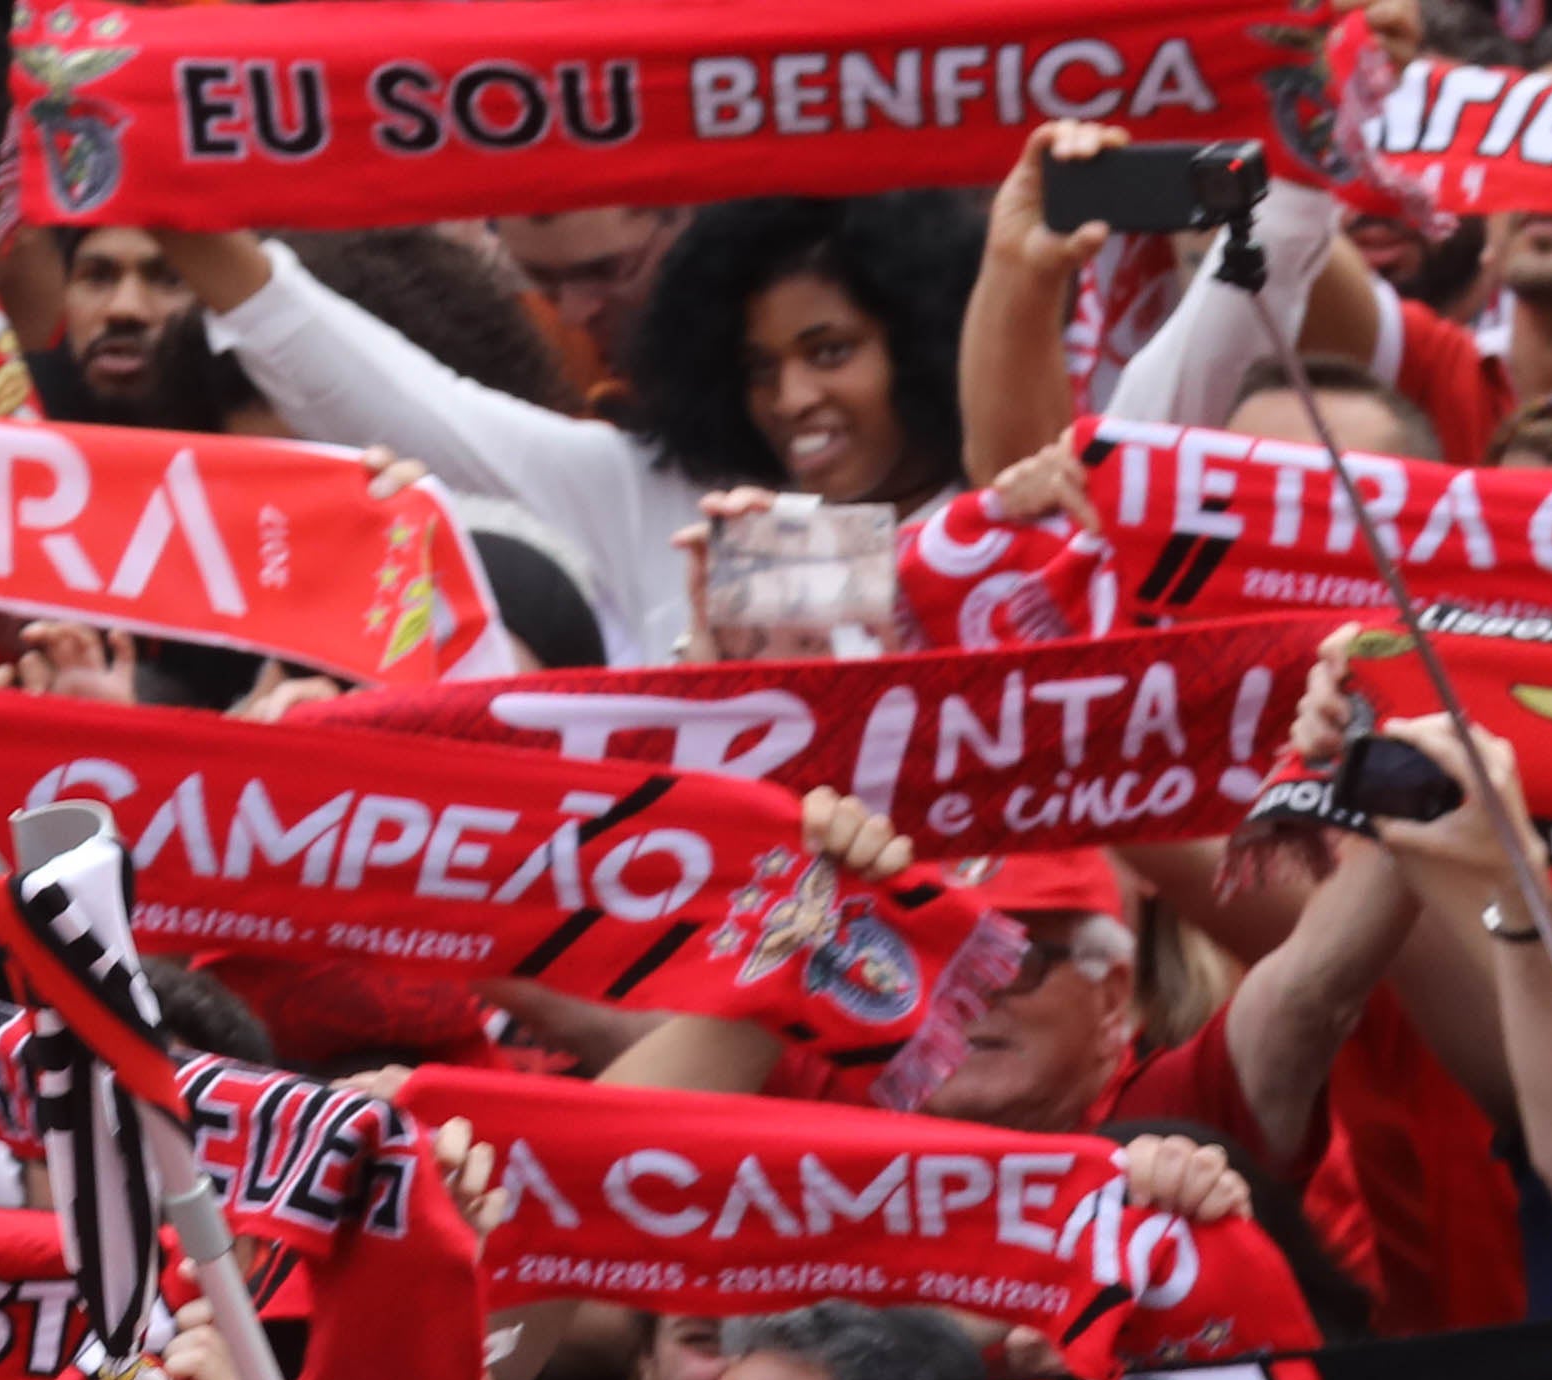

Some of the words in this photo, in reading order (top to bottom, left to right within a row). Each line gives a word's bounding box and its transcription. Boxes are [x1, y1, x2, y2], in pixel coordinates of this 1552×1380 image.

[176, 60, 332, 162] EU
[369, 60, 642, 155] SOU
[692, 38, 1218, 142] BENFICA
[1107, 419, 1496, 574] TETRA
[925, 792, 977, 835] e
[324, 921, 494, 964] 2016/2017
